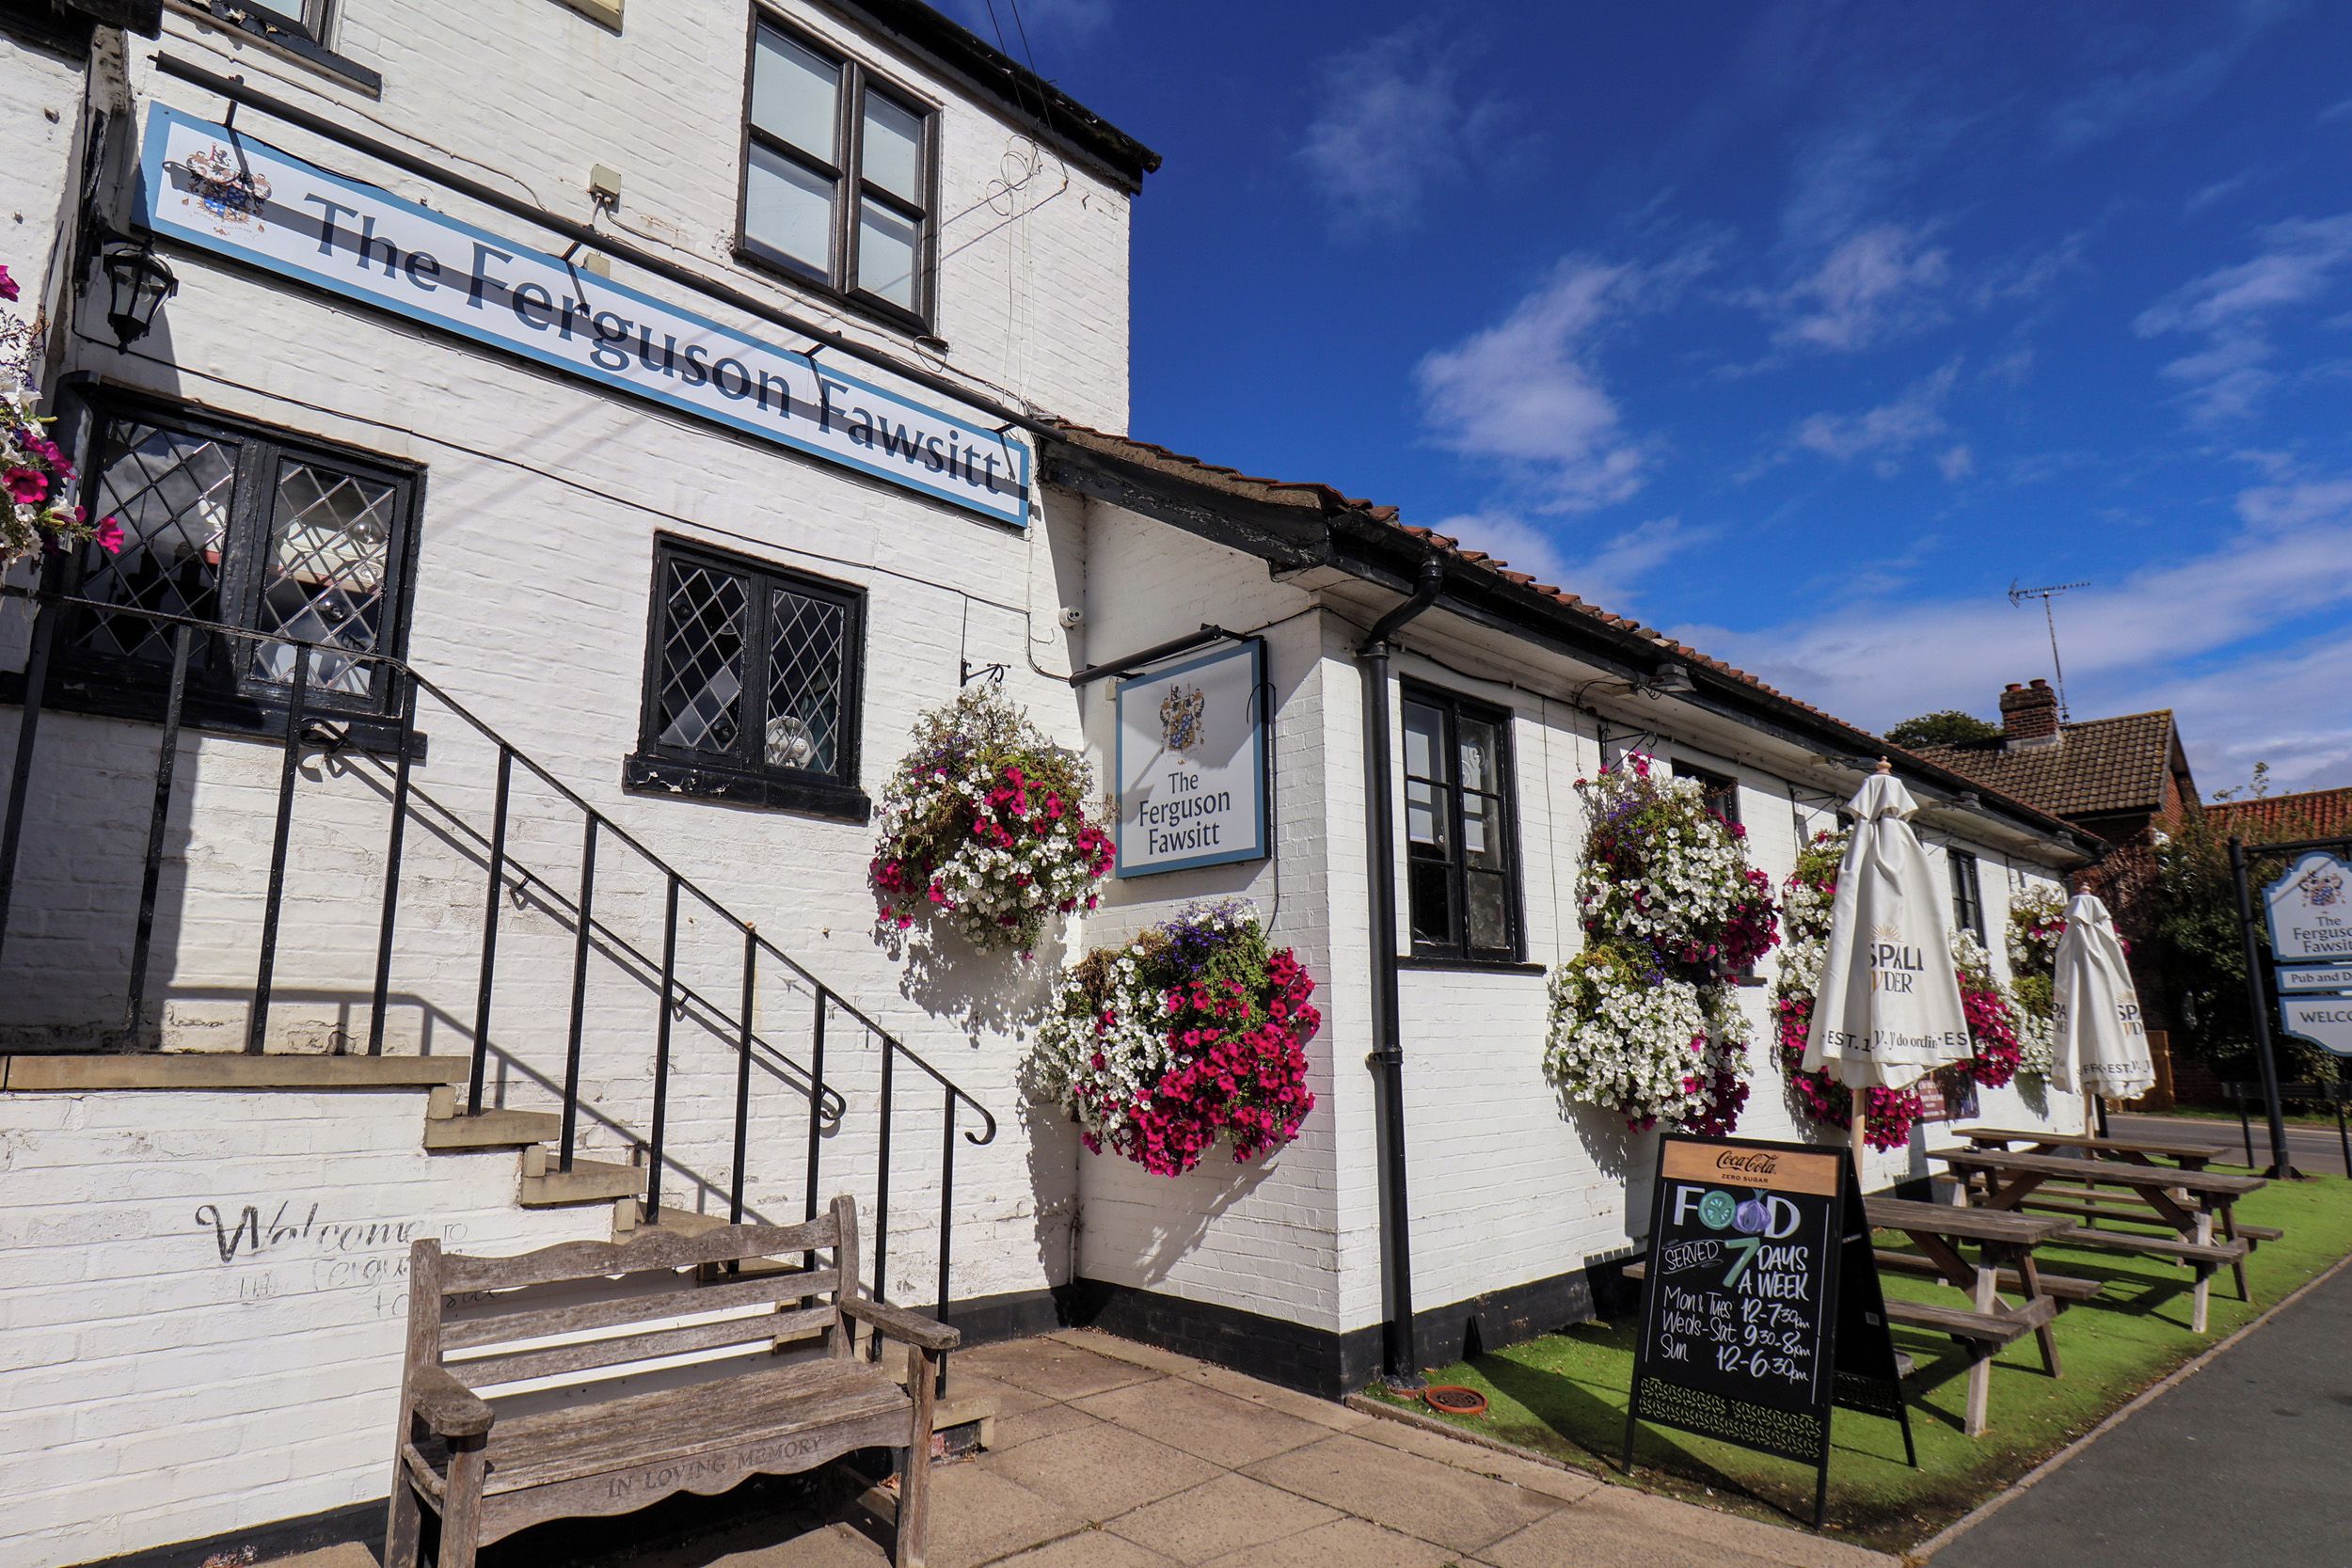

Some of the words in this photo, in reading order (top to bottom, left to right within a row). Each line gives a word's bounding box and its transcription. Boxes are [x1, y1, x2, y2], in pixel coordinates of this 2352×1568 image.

[304, 192, 440, 293] The
[467, 241, 791, 420] Ferguson
[818, 377, 1002, 496] Fawsitt
[1168, 771, 1200, 794] The
[1139, 791, 1231, 829] Ferguson
[1149, 821, 1220, 855] Fawsitt
[2315, 916, 2342, 927] The
[2291, 973, 2314, 984] Pub
[2317, 972, 2340, 983] and
[1897, 1033, 1908, 1046] do
[1722, 1173, 1740, 1181] ZERO
[1742, 1175, 1769, 1184] SUGAR
[1664, 1240, 1719, 1271] SERVED
[1722, 1236, 1760, 1288] 7
[1756, 1244, 1809, 1272] DAYS
[1663, 1285, 1695, 1311] Mon
[1706, 1291, 1733, 1319] Tues
[1738, 1268, 1752, 1294] A
[1757, 1271, 1809, 1302] WEEK
[1662, 1308, 1738, 1343] Weds-Sat
[1661, 1333, 1690, 1362] Sun
[608, 1475, 632, 1497] IN
[644, 1456, 726, 1490] LOVING
[737, 1435, 823, 1469] MEMORY
